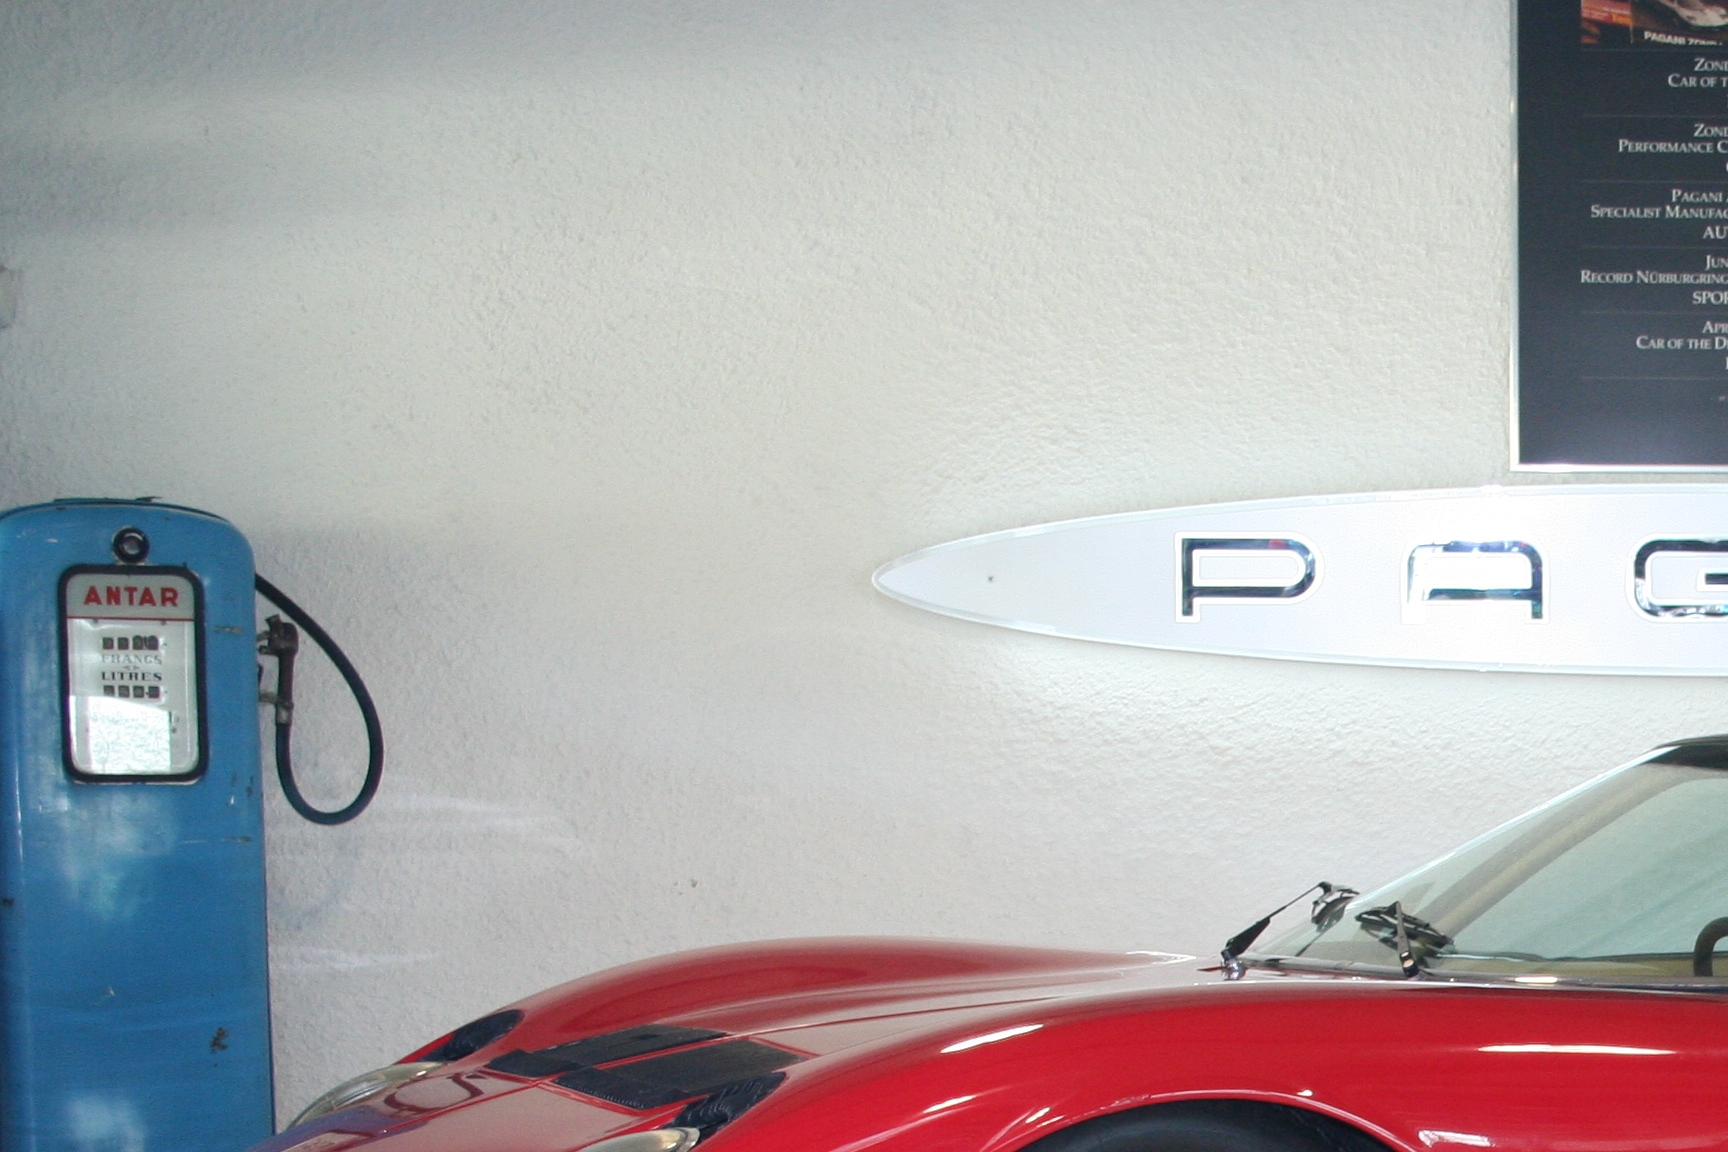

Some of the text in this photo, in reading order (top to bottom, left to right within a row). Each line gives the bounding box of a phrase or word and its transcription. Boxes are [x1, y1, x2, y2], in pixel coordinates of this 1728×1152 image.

[1667, 73, 1697, 88] CAR
[1699, 76, 1717, 88] OF
[1618, 138, 1713, 153] PERFORMANCE
[1671, 188, 1723, 203] PAGANI
[1590, 204, 1661, 219] SPECIALIST
[1580, 269, 1634, 284] RECORD
[1635, 335, 1665, 349] CAR
[1666, 338, 1684, 350] OF
[1687, 338, 1712, 350] THE
[84, 585, 178, 607] ANTAR
[101, 671, 162, 681] LITRES
